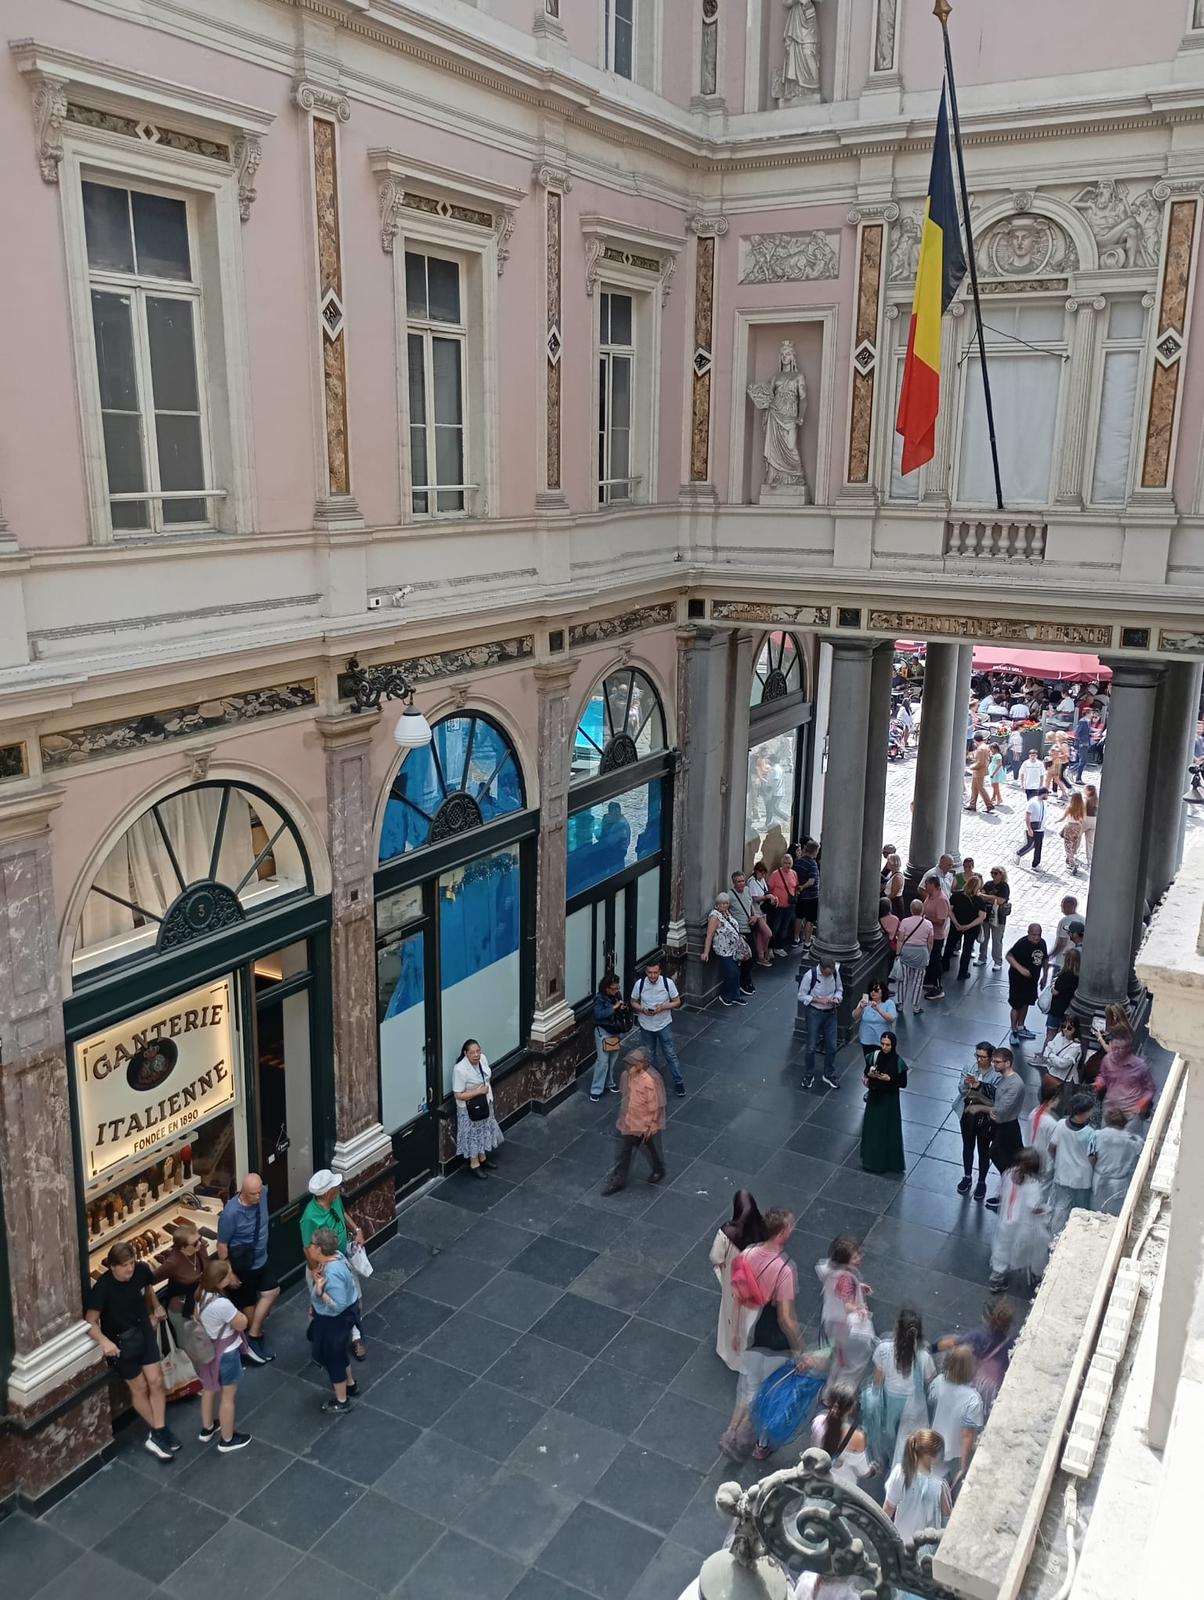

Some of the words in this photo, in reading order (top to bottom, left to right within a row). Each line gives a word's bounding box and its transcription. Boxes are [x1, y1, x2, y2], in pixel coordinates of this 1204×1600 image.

[92, 1004, 224, 1080] GANTERIE
[95, 1059, 228, 1146] ITALIENNE
[168, 1121, 179, 1134] EN
[180, 1109, 199, 1126] 1890
